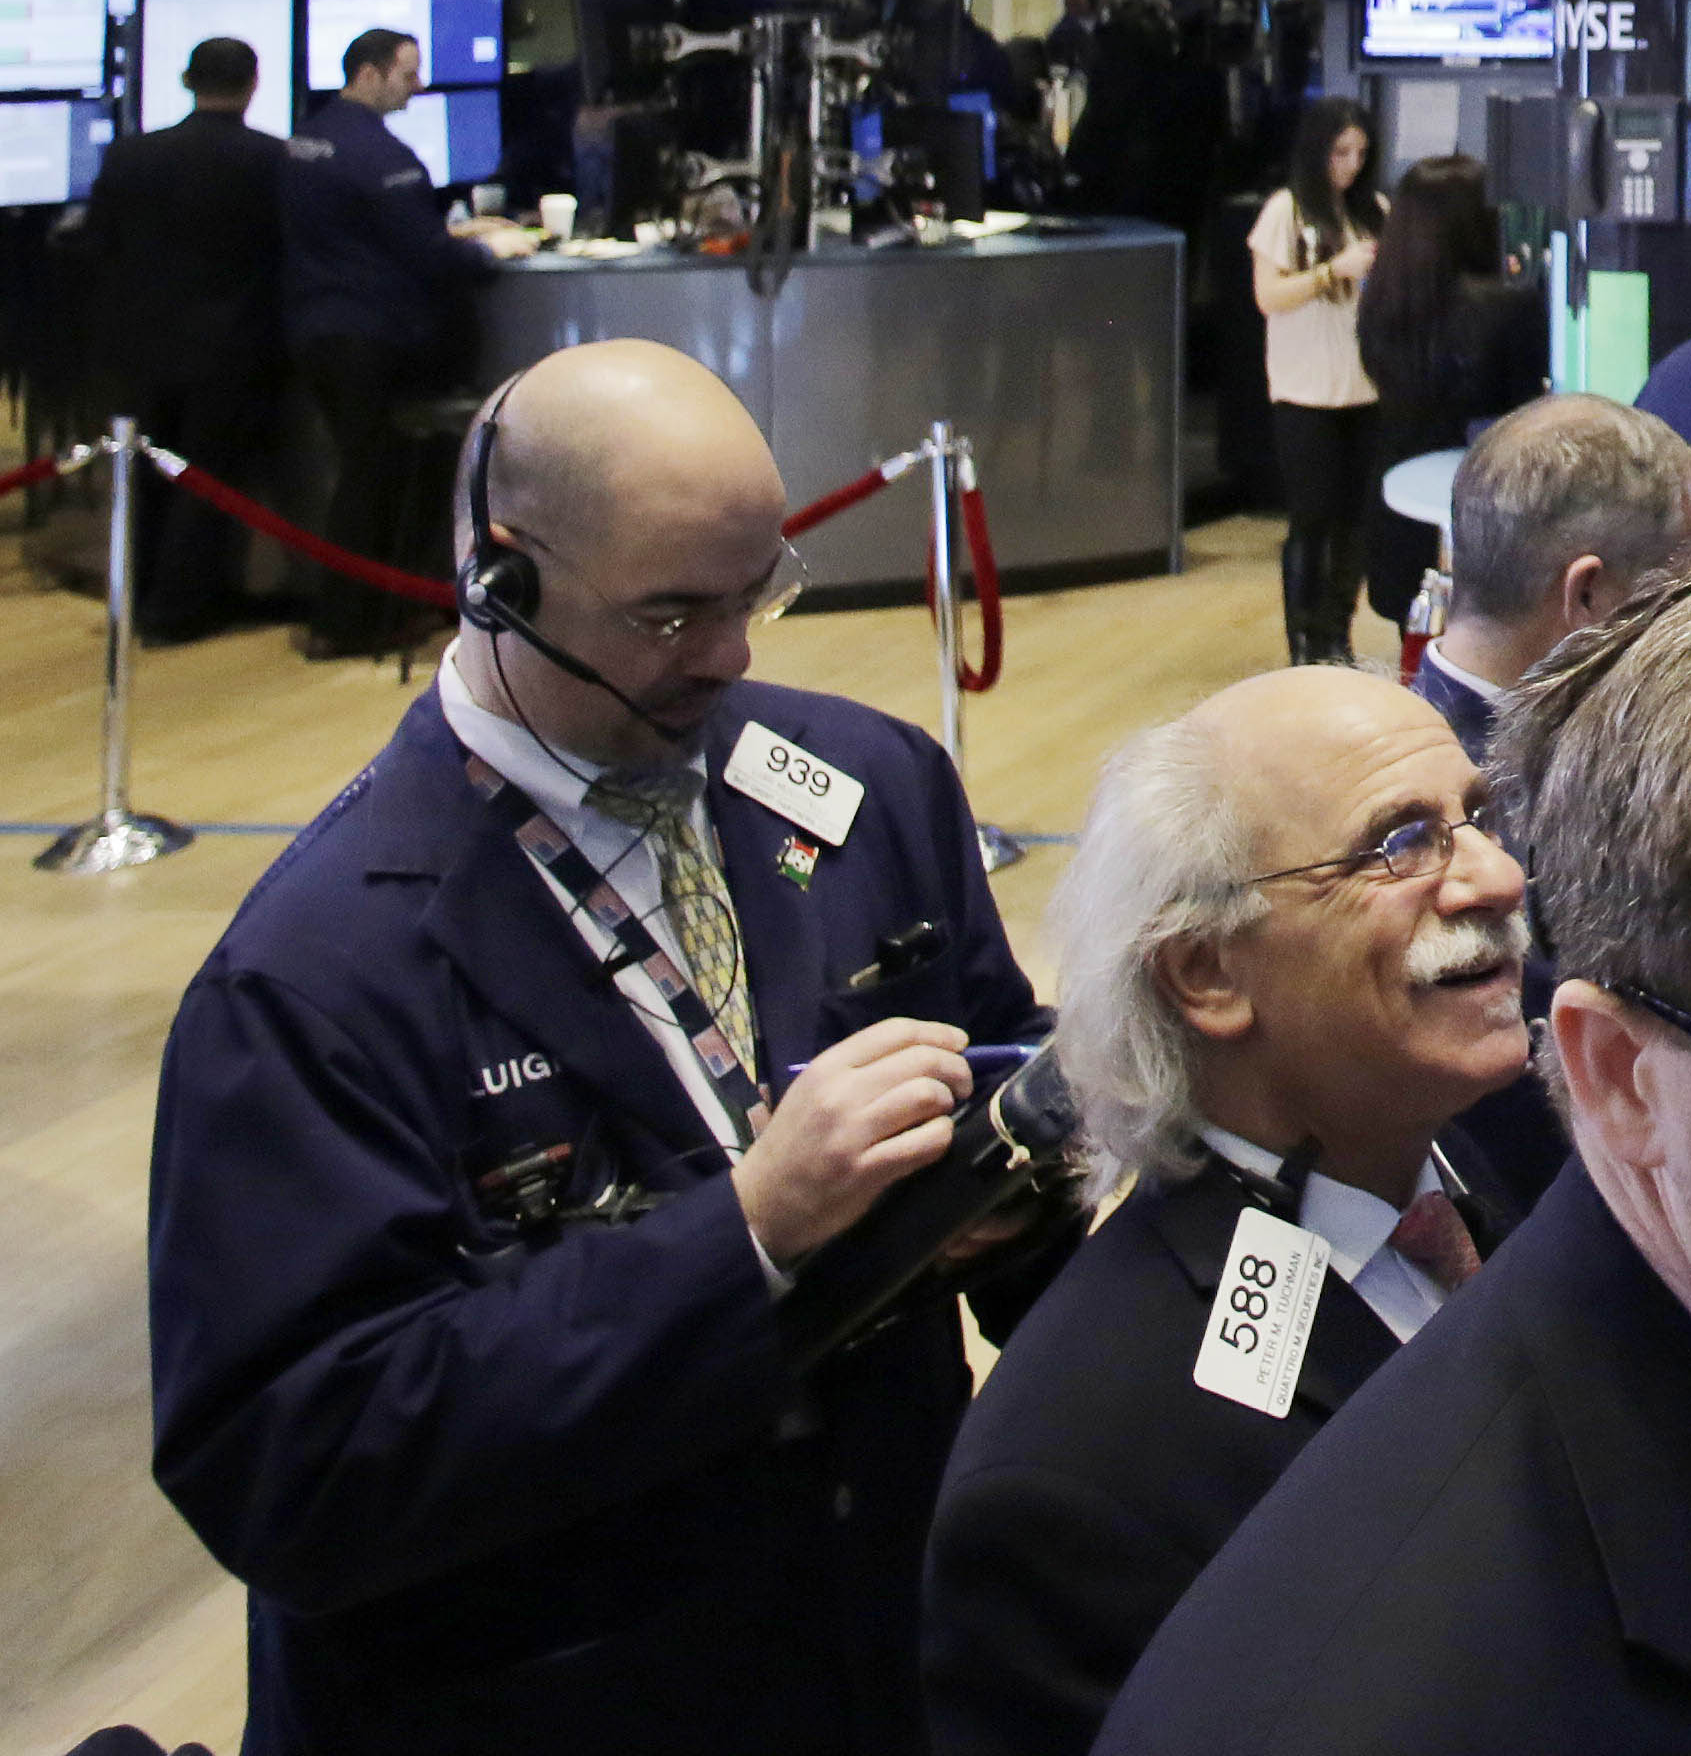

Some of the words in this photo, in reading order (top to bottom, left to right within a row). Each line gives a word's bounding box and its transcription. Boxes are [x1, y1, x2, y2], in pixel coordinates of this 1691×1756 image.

[766, 745, 831, 797] 939
[470, 1051, 560, 1099] UIG
[1218, 1254, 1278, 1355] 588
[1256, 1340, 1279, 1386] PETER
[1276, 1249, 1303, 1316] TUCHMAN
[1276, 1348, 1300, 1407] QUATTRO
